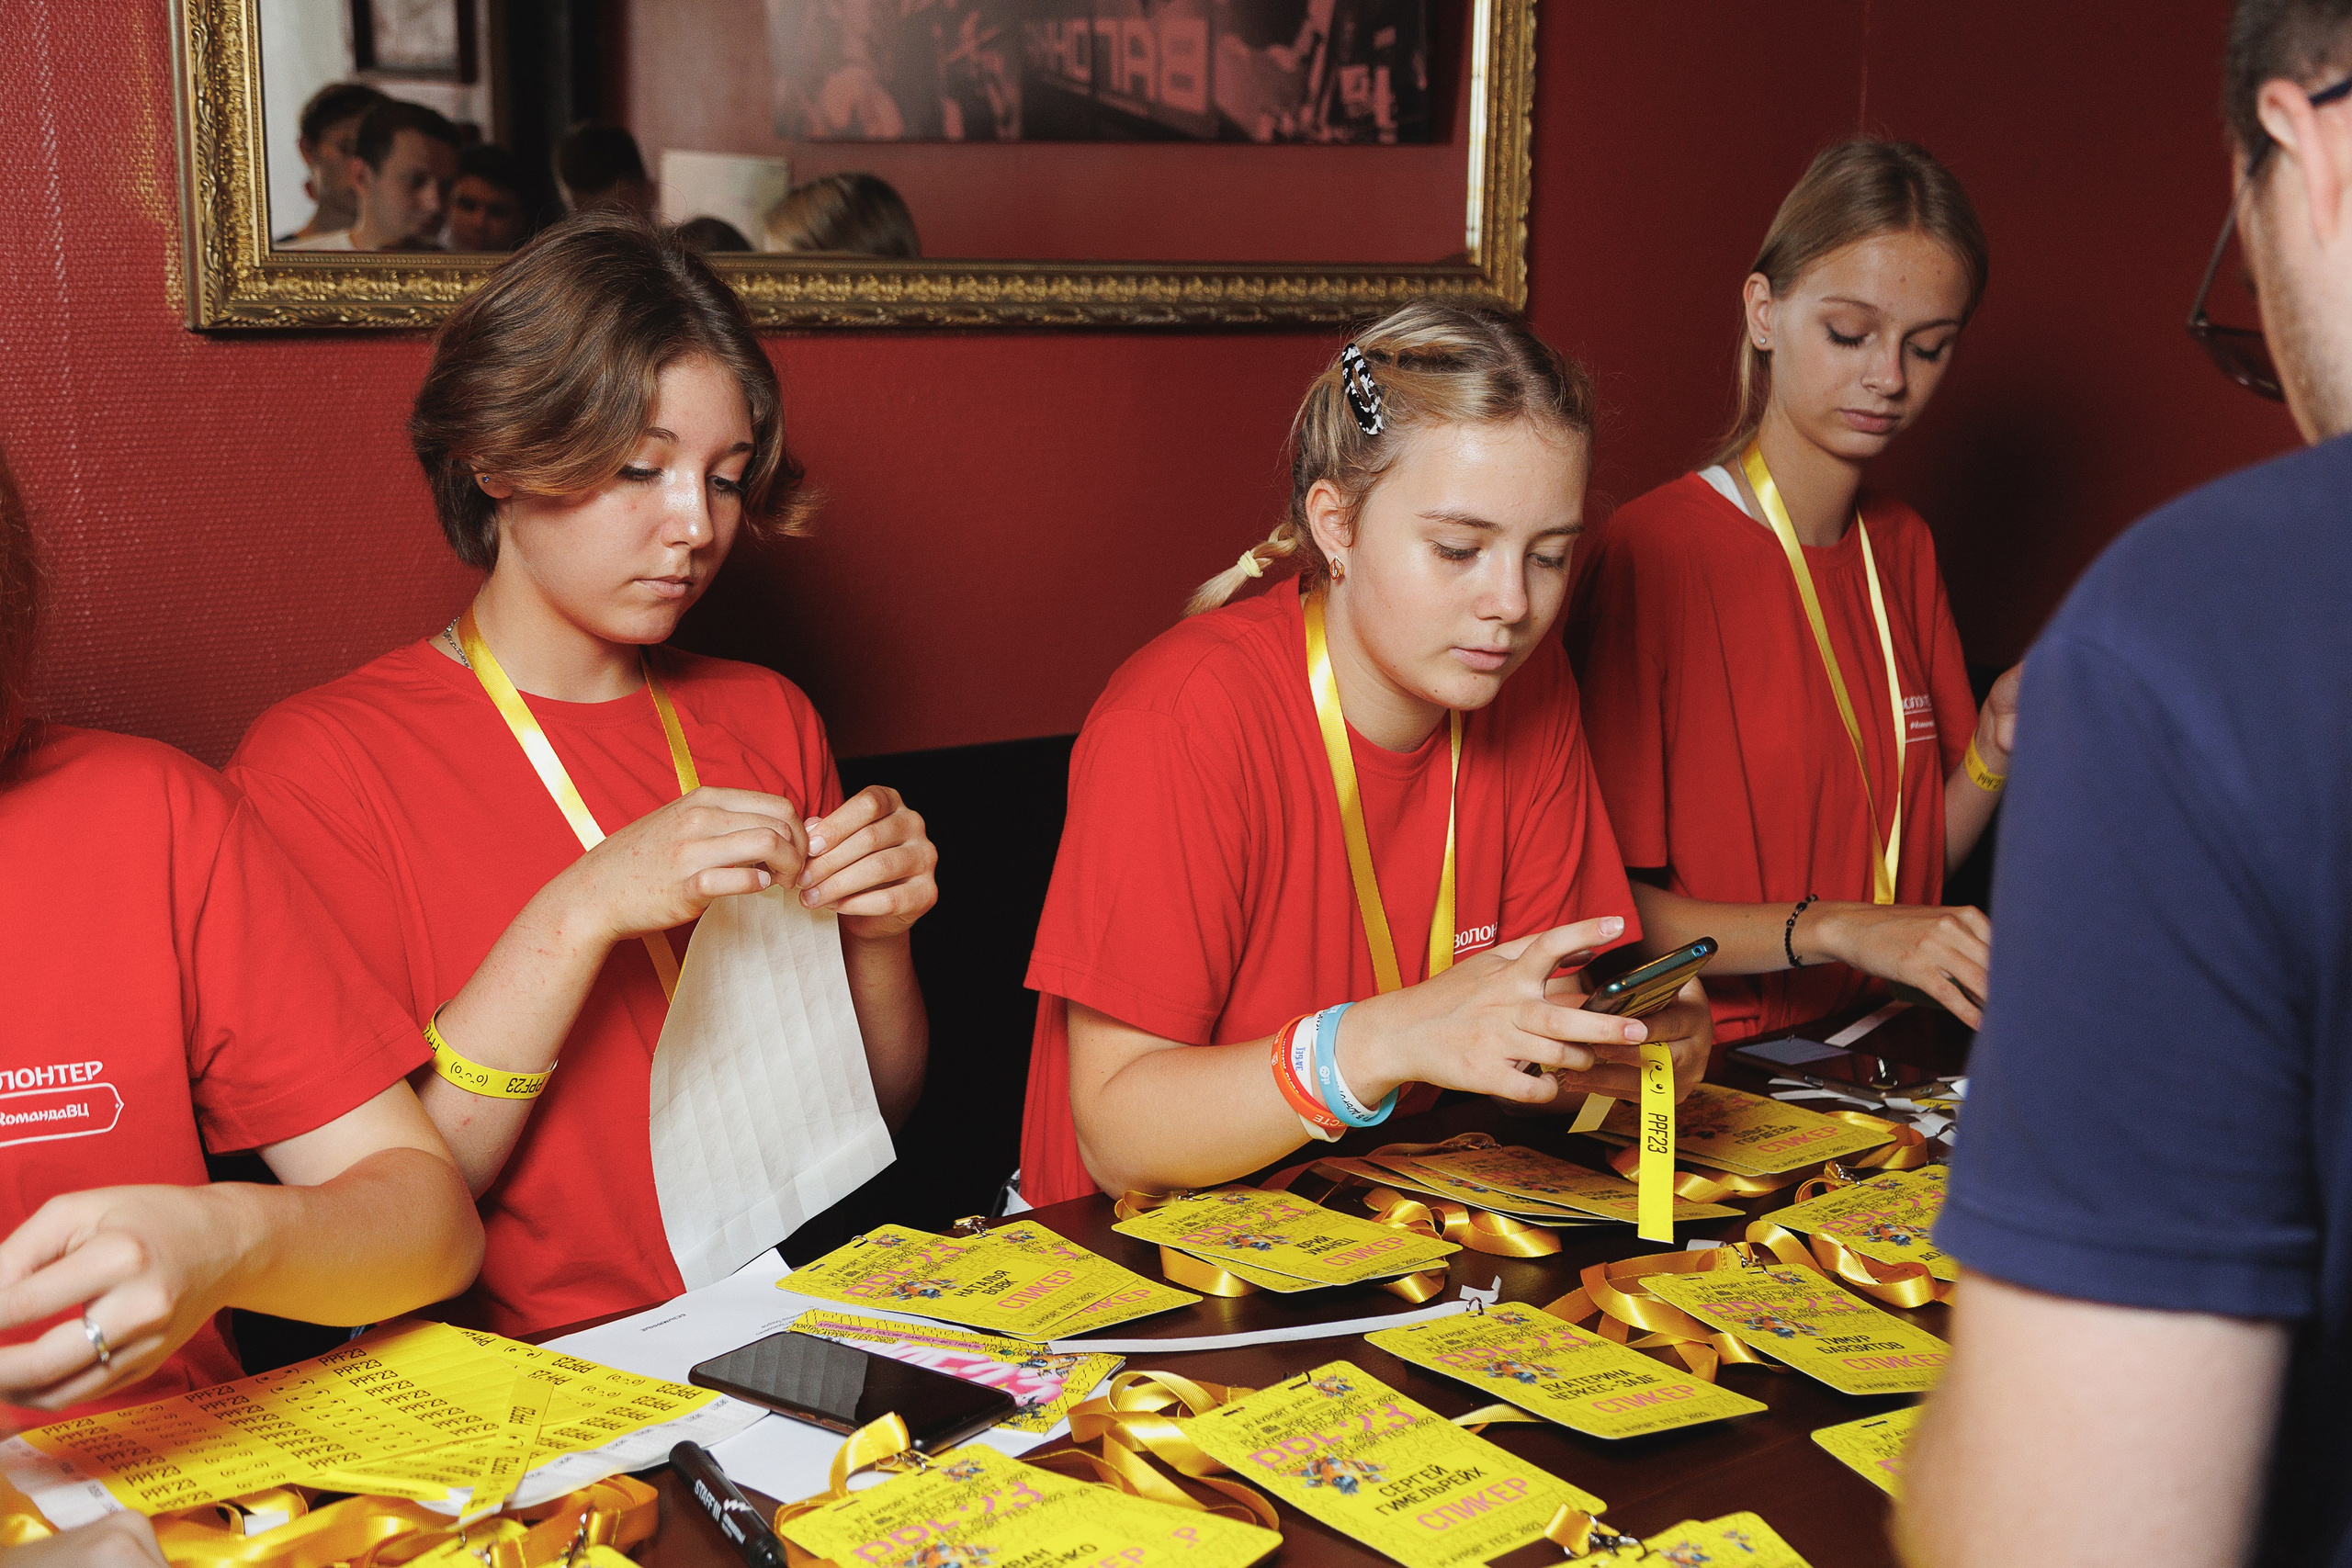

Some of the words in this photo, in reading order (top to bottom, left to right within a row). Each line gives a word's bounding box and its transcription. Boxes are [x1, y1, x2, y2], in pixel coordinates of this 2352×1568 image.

[0, 1061, 104, 1091] ЛОНТЕР
[505, 1077, 547, 1094] PPF23
[1647, 1112, 1668, 1155] PPF23
[1758, 1126, 1838, 1153] СПИКЕР
[1294, 1235, 1334, 1250] ЮРИЙ
[1303, 1237, 1360, 1256] УМАНЕЦ
[1322, 1236, 1406, 1267] СПИКЕР
[954, 1269, 1012, 1297] НАТАЛЬЯ
[981, 1279, 1019, 1296] ВОВК
[998, 1269, 1076, 1310] СПИКЕР
[875, 1329, 902, 1337] РОССИИ
[1815, 1335, 1871, 1346] ТИМУР
[318, 1348, 368, 1366] PPF23
[1815, 1341, 1905, 1355] БАЯЗИТОВ
[334, 1359, 383, 1377] PPF23
[552, 1357, 597, 1374] PPF23
[1842, 1353, 1949, 1371] СПИКЕР
[349, 1370, 398, 1388] PPF23
[1541, 1369, 1634, 1393] ЕКАТЕРИНА
[1547, 1373, 1663, 1401] ЧЕРКЕС-ЗАДЕ
[185, 1385, 235, 1404] PPF23
[365, 1380, 414, 1397] PPF23
[381, 1389, 431, 1405] PPF23
[656, 1383, 703, 1399] PPF23
[199, 1395, 250, 1413] PPF23
[398, 1399, 448, 1414] PPF23
[631, 1395, 679, 1411] PPF23
[1590, 1384, 1696, 1414] СПИКЕР
[214, 1404, 265, 1420] PPF23
[230, 1414, 280, 1427] PPF23
[414, 1407, 465, 1422] PPF23
[509, 1406, 537, 1426] PPF23
[605, 1406, 654, 1421] PPF23
[1241, 1409, 1292, 1429] PLAYPORT
[243, 1421, 296, 1434] PPF23
[432, 1416, 483, 1430] PPF23
[449, 1423, 500, 1437] PPF23
[579, 1416, 628, 1431] PPF23
[259, 1428, 311, 1441] PPF23
[275, 1436, 328, 1450] PPF23
[553, 1427, 602, 1441] PPF23
[1251, 1429, 1300, 1450] PLAYPORT
[1337, 1439, 1383, 1459] PLAYPORT
[1385, 1427, 1411, 1438] FEST
[1410, 1416, 1437, 1427] 2023
[291, 1444, 345, 1460] PPF23
[308, 1452, 362, 1470] PPF23
[125, 1465, 182, 1487] PPF23
[1379, 1463, 1451, 1497] СЕРГЕЙ
[140, 1479, 197, 1501] PPF23
[1374, 1466, 1488, 1516] ГИМЕЛЬРЕЙХ
[1417, 1477, 1529, 1531] СПИКЕР
[1487, 1533, 1516, 1546] FEST
